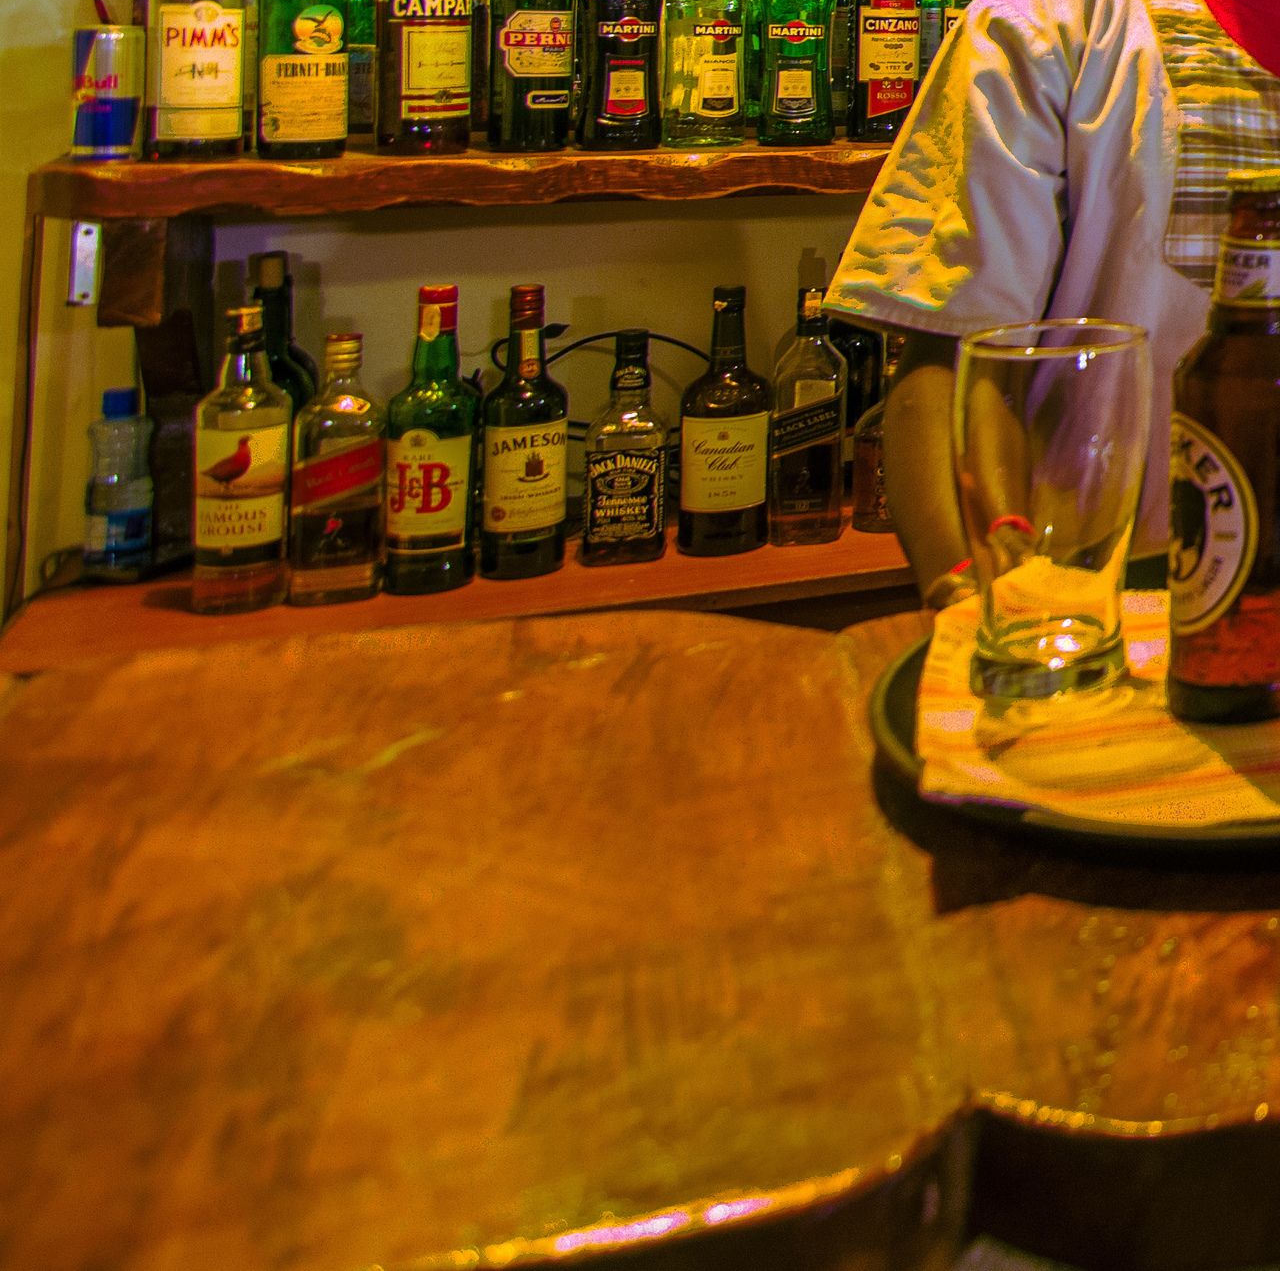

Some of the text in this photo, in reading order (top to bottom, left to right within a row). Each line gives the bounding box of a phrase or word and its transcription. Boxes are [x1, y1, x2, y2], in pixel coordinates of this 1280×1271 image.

[602, 24, 655, 34] MARTINI
[695, 25, 742, 35] MARTINI
[771, 27, 822, 36] MARTINI
[865, 18, 919, 32] CINZANO
[165, 23, 240, 48] PIMM'S
[876, 92, 908, 100] ROSSO
[492, 432, 567, 457] JAMESON
[691, 439, 755, 456] Canadian
[590, 459, 616, 478] JACK
[704, 456, 742, 471] Club
[390, 461, 454, 515] J&B
[593, 505, 650, 518] WHISKEY
